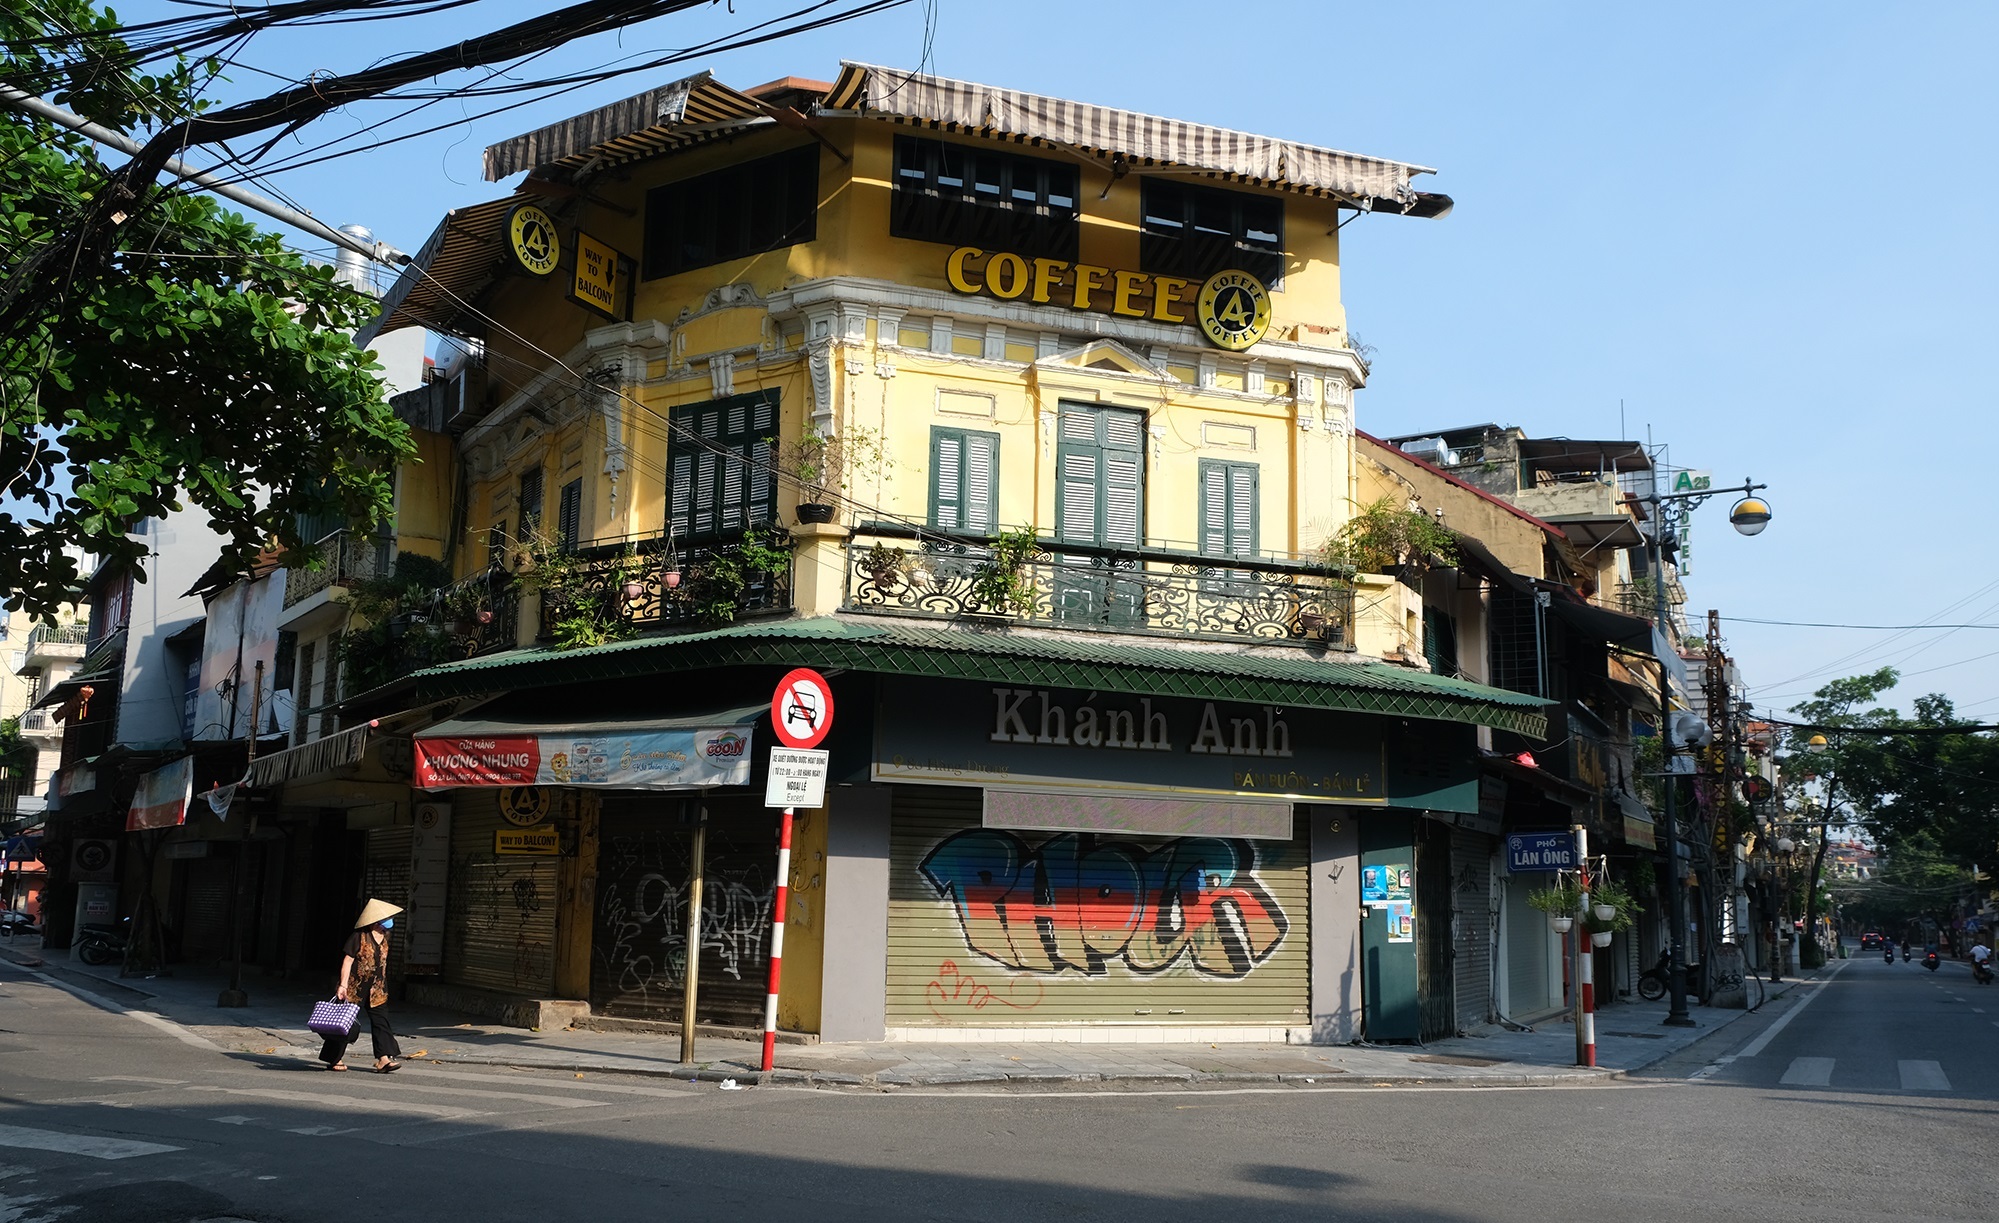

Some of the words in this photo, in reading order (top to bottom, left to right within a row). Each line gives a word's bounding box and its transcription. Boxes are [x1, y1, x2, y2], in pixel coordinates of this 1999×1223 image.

[519, 211, 556, 240] COFFEE
[525, 224, 548, 257] A
[518, 244, 552, 269] COFFEE
[584, 248, 602, 264] WAY
[587, 263, 598, 276] TO
[578, 277, 612, 305] BALCONY
[945, 246, 1188, 323] COFFEE
[1211, 273, 1264, 303] COFFEE
[1218, 289, 1253, 329] A
[1205, 316, 1260, 344] COFFEE
[990, 687, 1172, 751] Khánh
[1190, 701, 1293, 757] Anh
[474, 739, 496, 750] HÀNG
[422, 753, 479, 769] PHƯƠNG
[482, 752, 529, 768] NHUNG
[927, 757, 962, 777] Hàng
[1233, 768, 1265, 788] BÁN
[1269, 770, 1309, 790] BUÔN
[1322, 772, 1352, 791] BÁN
[506, 807, 543, 823] COFFEE
[500, 836, 513, 845] WAY
[514, 836, 522, 845] TO
[523, 835, 557, 846] BALCONY
[1536, 837, 1557, 848] PHỐ
[1514, 850, 1540, 866] LÃN
[1542, 848, 1570, 865] ÔNG
